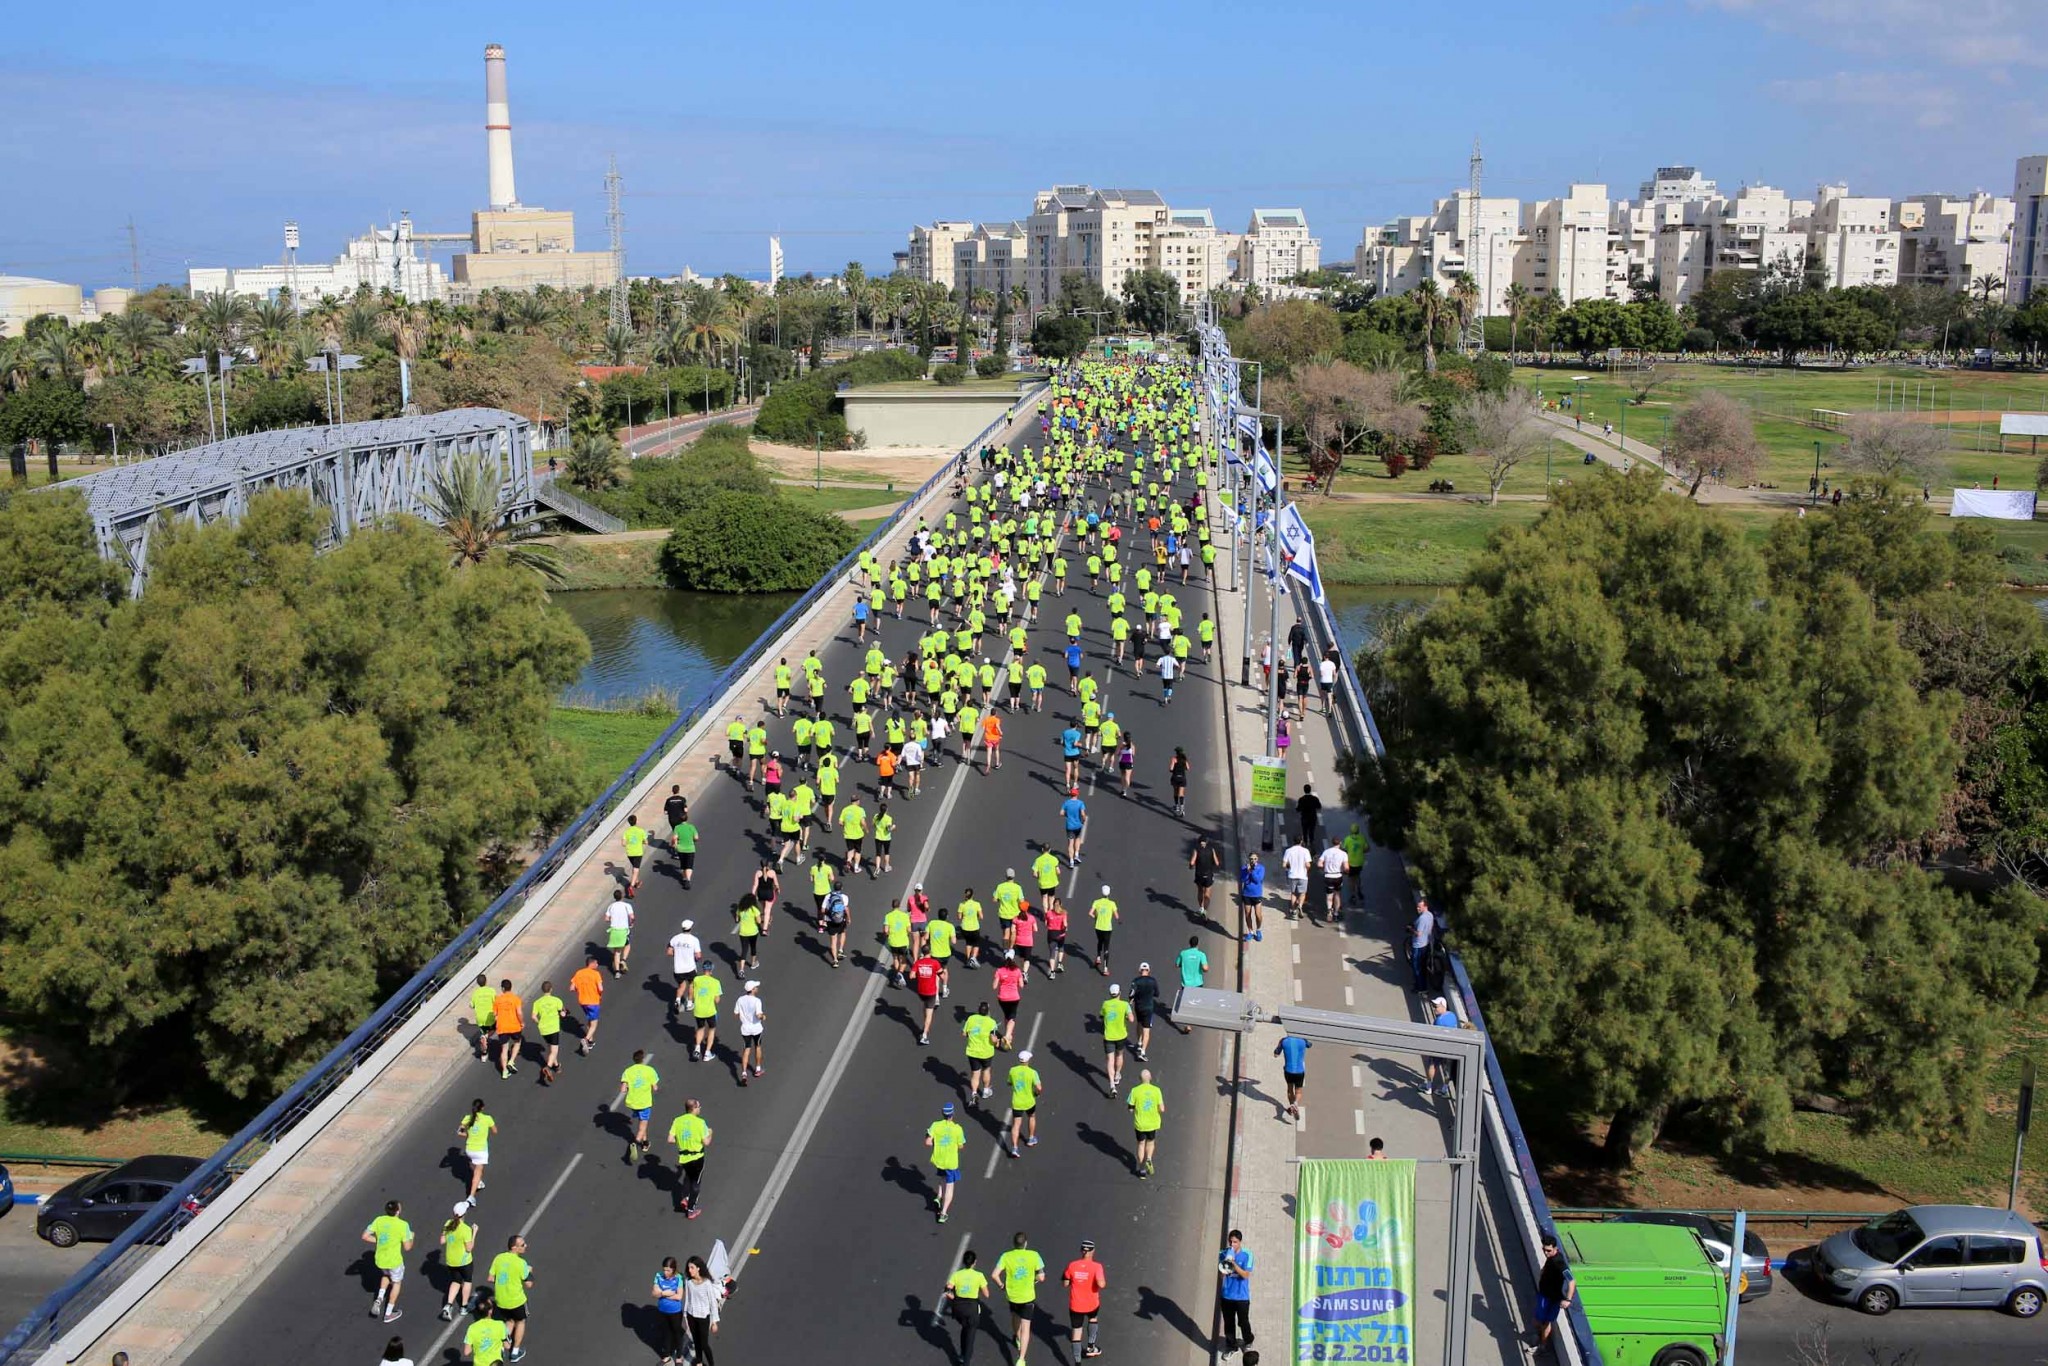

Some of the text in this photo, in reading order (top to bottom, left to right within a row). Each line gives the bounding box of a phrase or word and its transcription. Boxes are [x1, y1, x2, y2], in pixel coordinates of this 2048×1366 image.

[1315, 1265, 1392, 1287] מרתון
[1312, 1297, 1395, 1312] SAMSUNG
[1298, 1343, 1409, 1364] 28.2.2014
